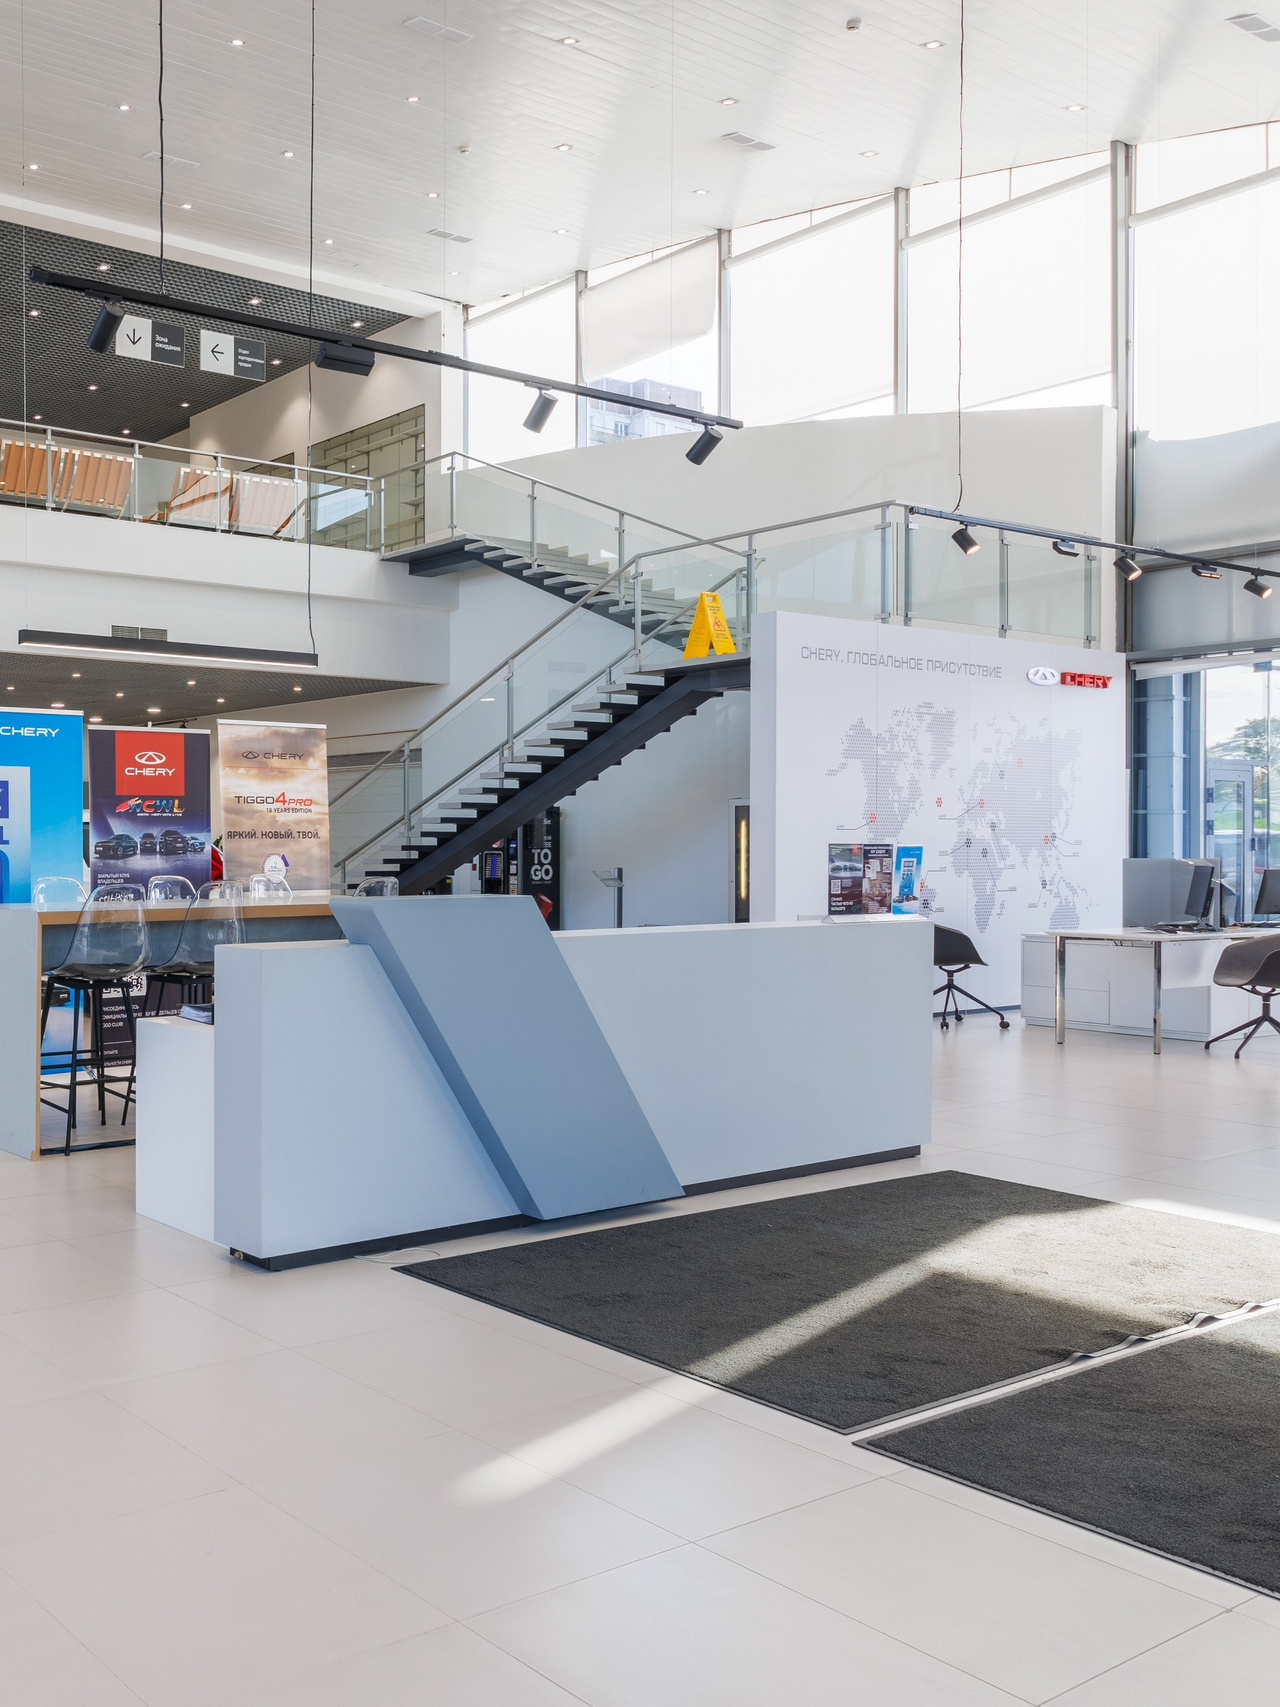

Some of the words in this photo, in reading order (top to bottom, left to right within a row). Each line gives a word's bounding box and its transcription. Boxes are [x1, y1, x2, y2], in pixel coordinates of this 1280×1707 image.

[155, 334, 169, 343] Зона
[155, 342, 181, 352] ожидания
[801, 646, 844, 663] CHERY.
[846, 651, 923, 671] ГЛОБАЛЬНОЕ
[926, 659, 1002, 679] ПРИСУТСТВИЕ
[1062, 671, 1114, 689] CHERY
[0, 726, 60, 738] CHERY
[263, 752, 304, 760] CHERY
[124, 767, 176, 777] CHERY
[226, 829, 259, 839] ЯРКИЙ.
[261, 829, 295, 839] НОВЫЙ.
[296, 829, 321, 839] ТВОЙ.
[532, 848, 552, 864] TO
[531, 864, 553, 881] GO
